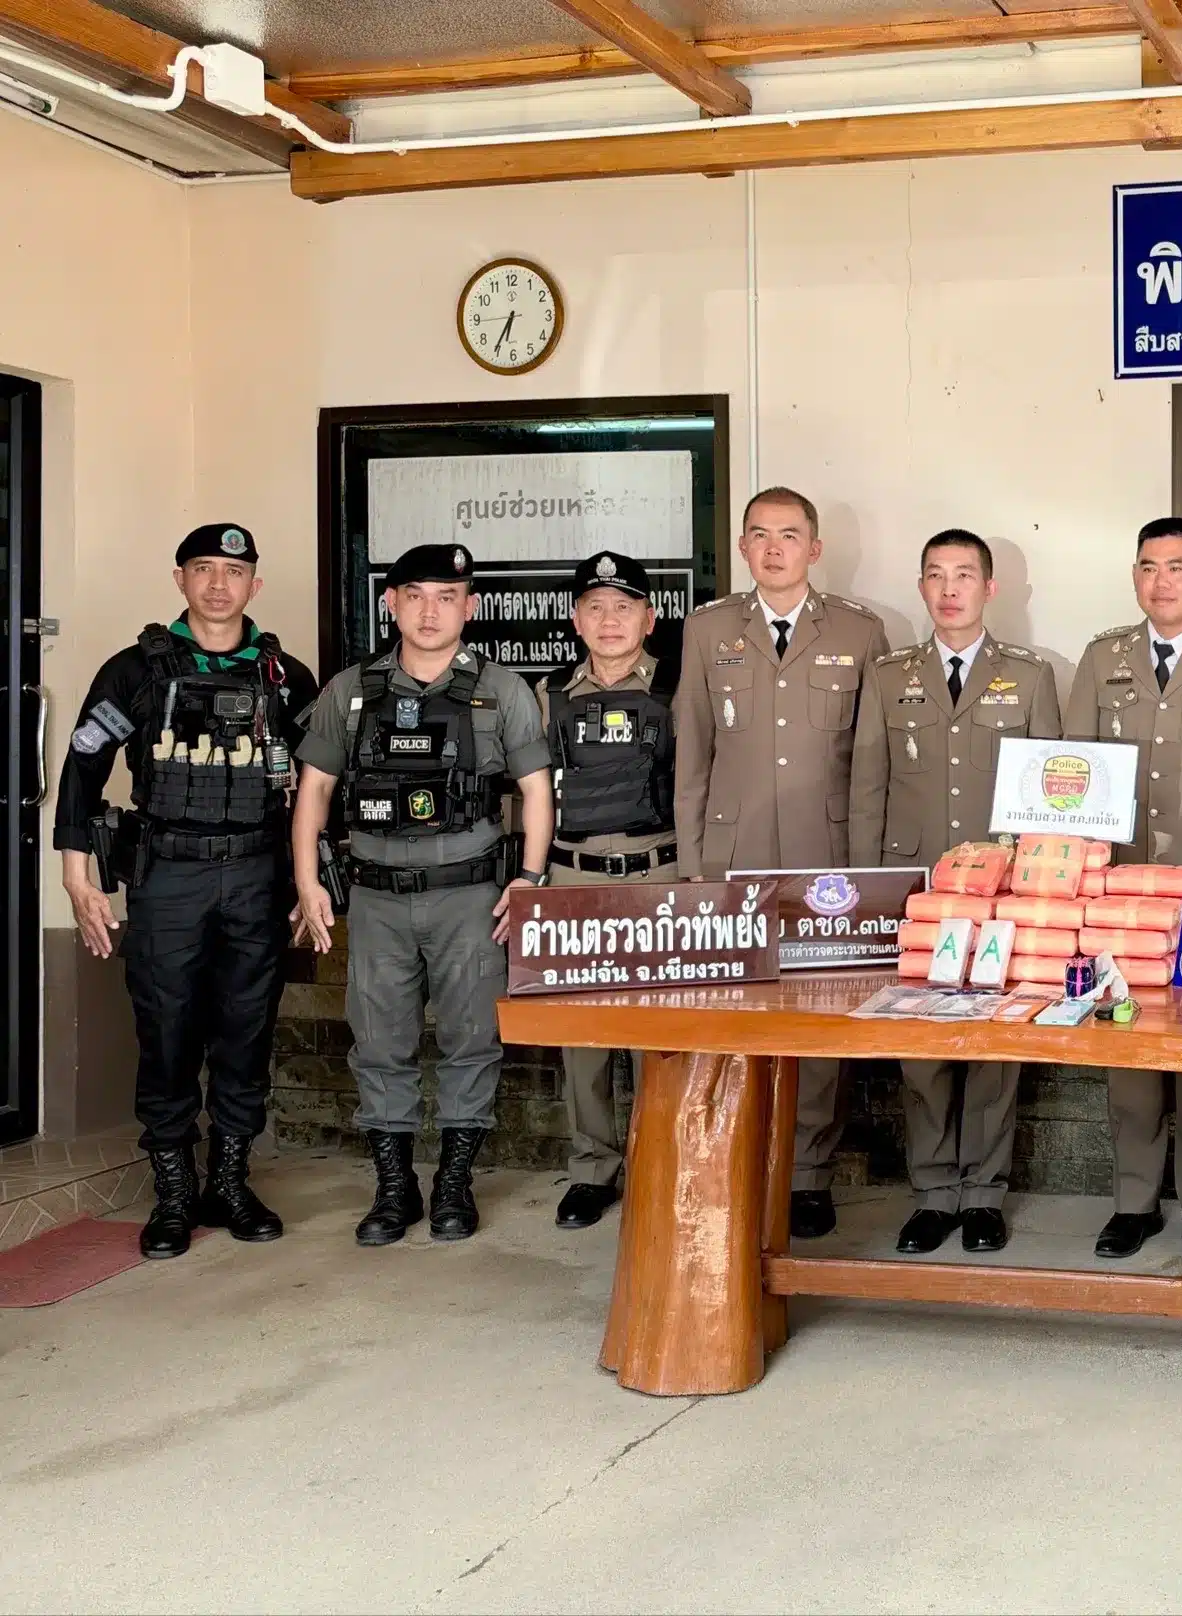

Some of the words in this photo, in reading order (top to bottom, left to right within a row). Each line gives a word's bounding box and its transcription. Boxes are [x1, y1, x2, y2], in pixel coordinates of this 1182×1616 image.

[506, 274, 517, 286] 12
[490, 281, 499, 293] 11
[478, 294, 491, 306] 10
[538, 290, 546, 302] 2
[473, 314, 480, 326] 9
[545, 309, 552, 321] 3
[480, 333, 487, 345] 8
[540, 329, 546, 341] 4
[510, 349, 517, 361] 6
[526, 343, 534, 355] 5
[576, 721, 633, 744] PICE
[392, 738, 429, 750] POLICE
[1052, 760, 1083, 770] Police
[360, 800, 392, 809] POLICE
[521, 884, 768, 957] ด่านตรวจกิ่วทัพยั้ง
[936, 931, 958, 960] A
[980, 935, 1001, 964] A
[543, 960, 630, 985] อ.แม่จัน
[636, 957, 745, 982] จ.เชียงราย
